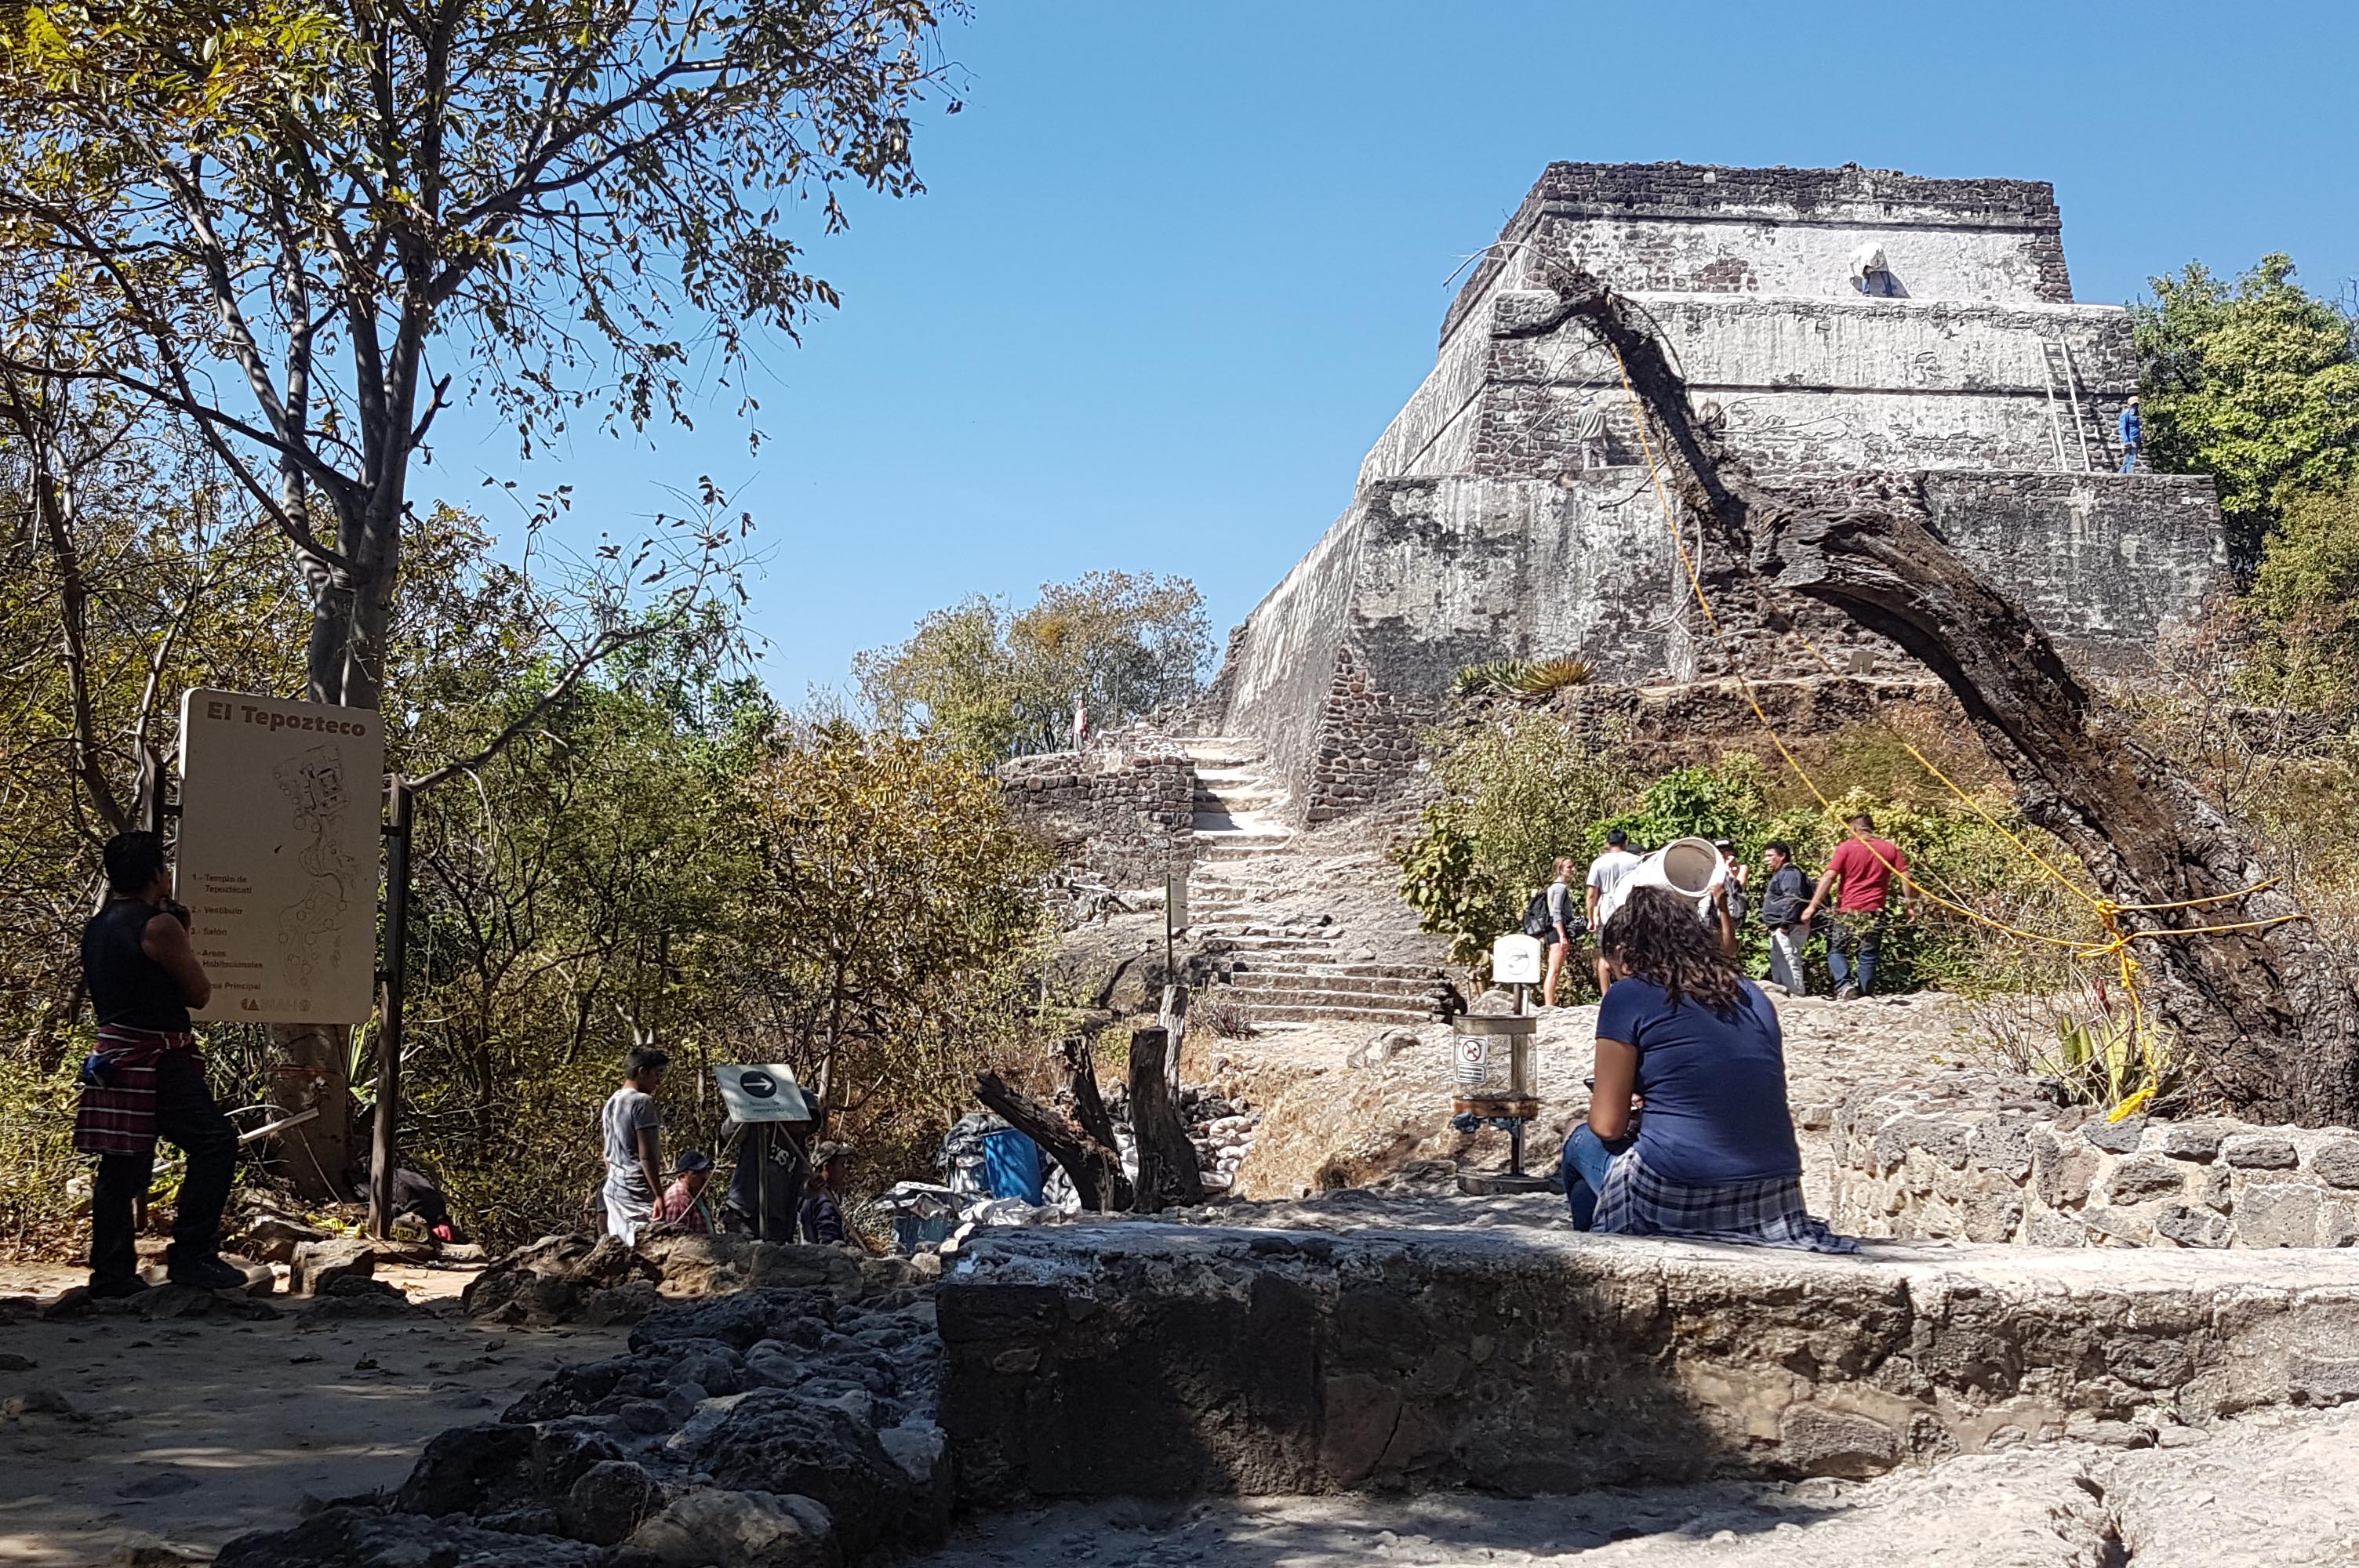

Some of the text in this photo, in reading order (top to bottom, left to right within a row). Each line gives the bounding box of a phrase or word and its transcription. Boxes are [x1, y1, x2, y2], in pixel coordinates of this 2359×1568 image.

[207, 702, 365, 737] El Tepozteco
[205, 874, 234, 883] Templo
[203, 959, 263, 968] Habitacionales
[224, 982, 261, 991] Principal
